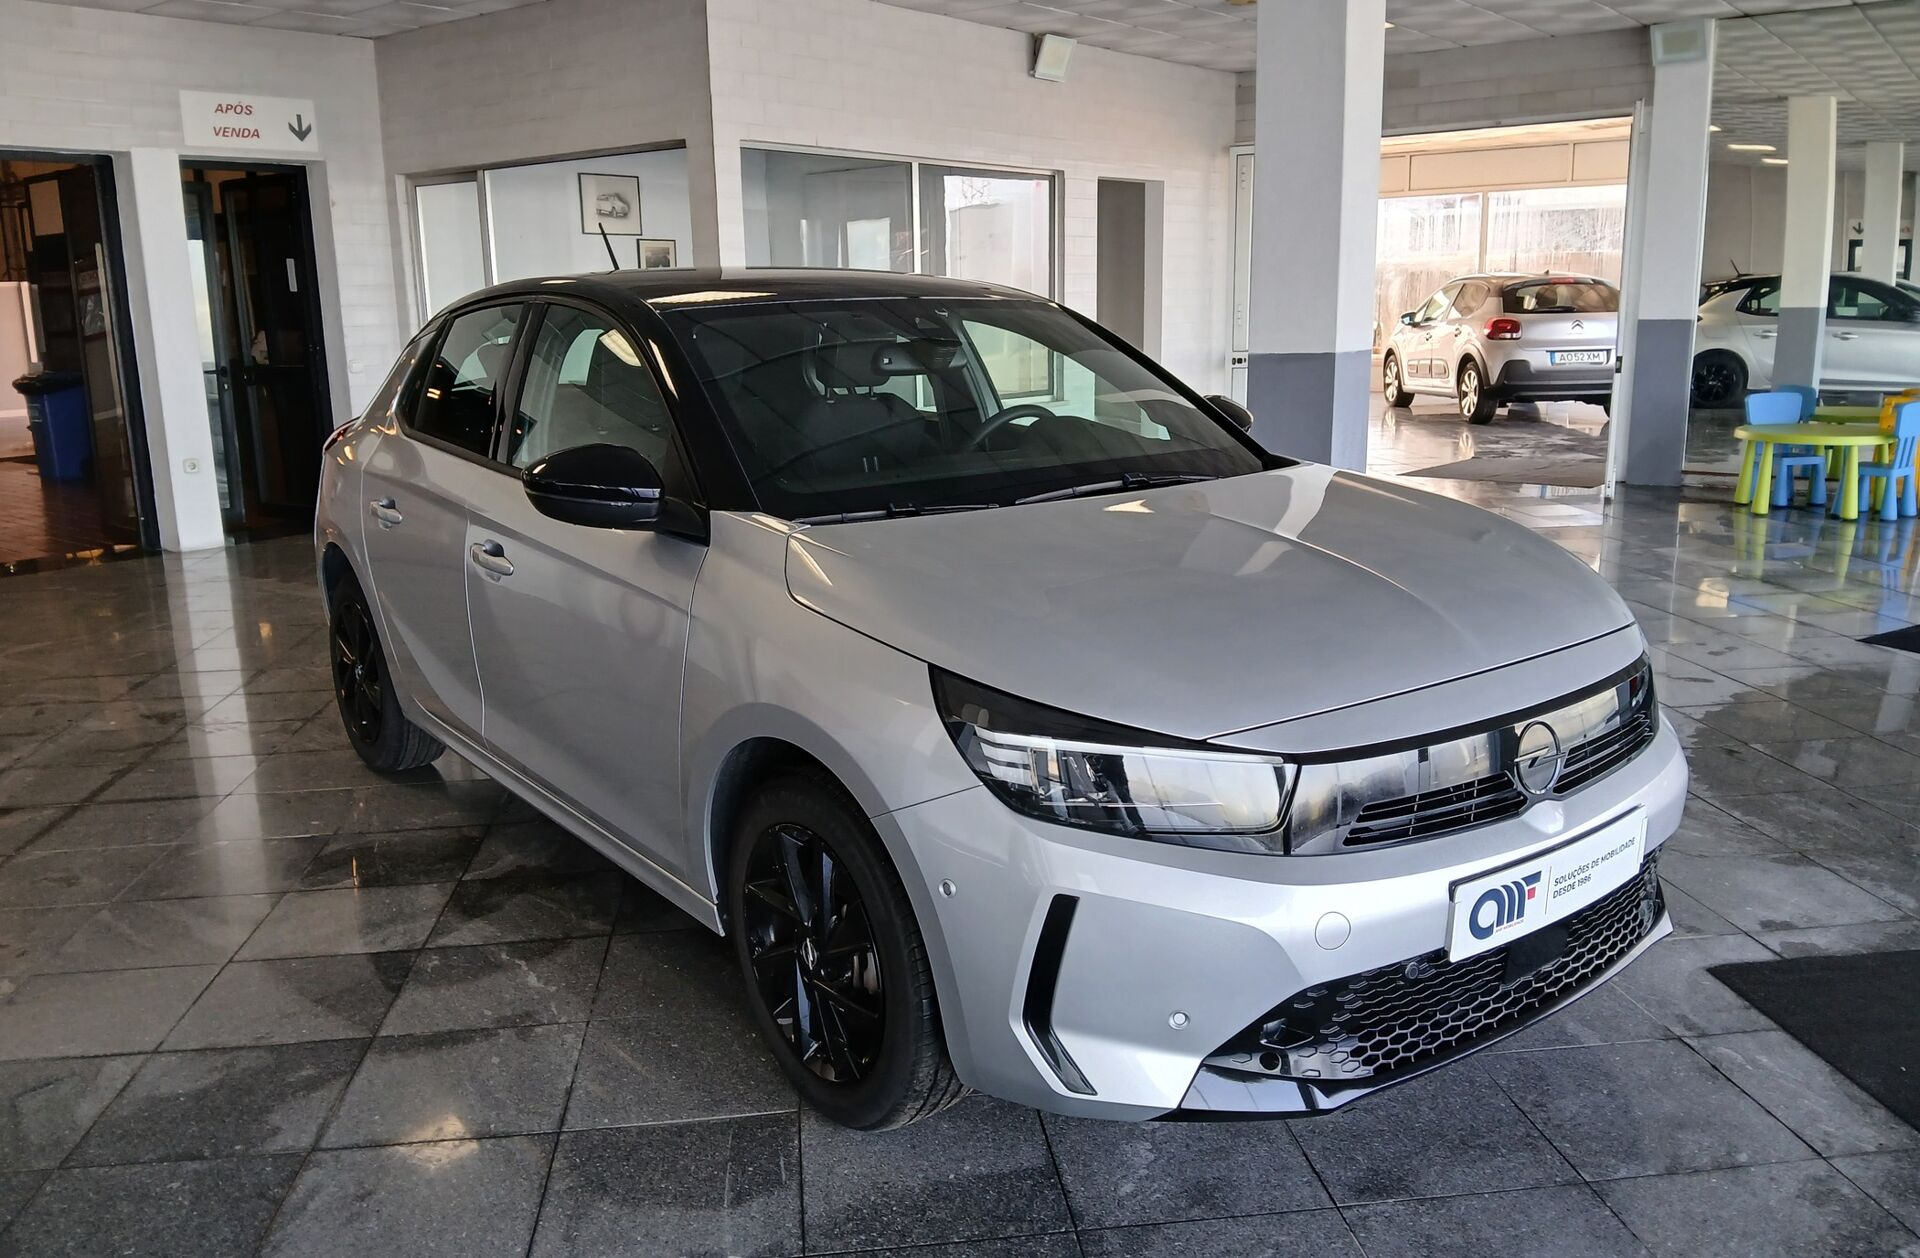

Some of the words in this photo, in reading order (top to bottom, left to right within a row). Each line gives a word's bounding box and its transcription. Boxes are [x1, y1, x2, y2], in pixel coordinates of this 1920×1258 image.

[214, 101, 253, 116] APÓS
[213, 126, 260, 139] VENDA
[1554, 862, 1590, 887] SOLUÇÕES
[1591, 857, 1600, 870] DE
[1601, 836, 1636, 864] MOBILIDADE
[1552, 881, 1577, 899] DESDE
[1577, 873, 1592, 888] 1986
